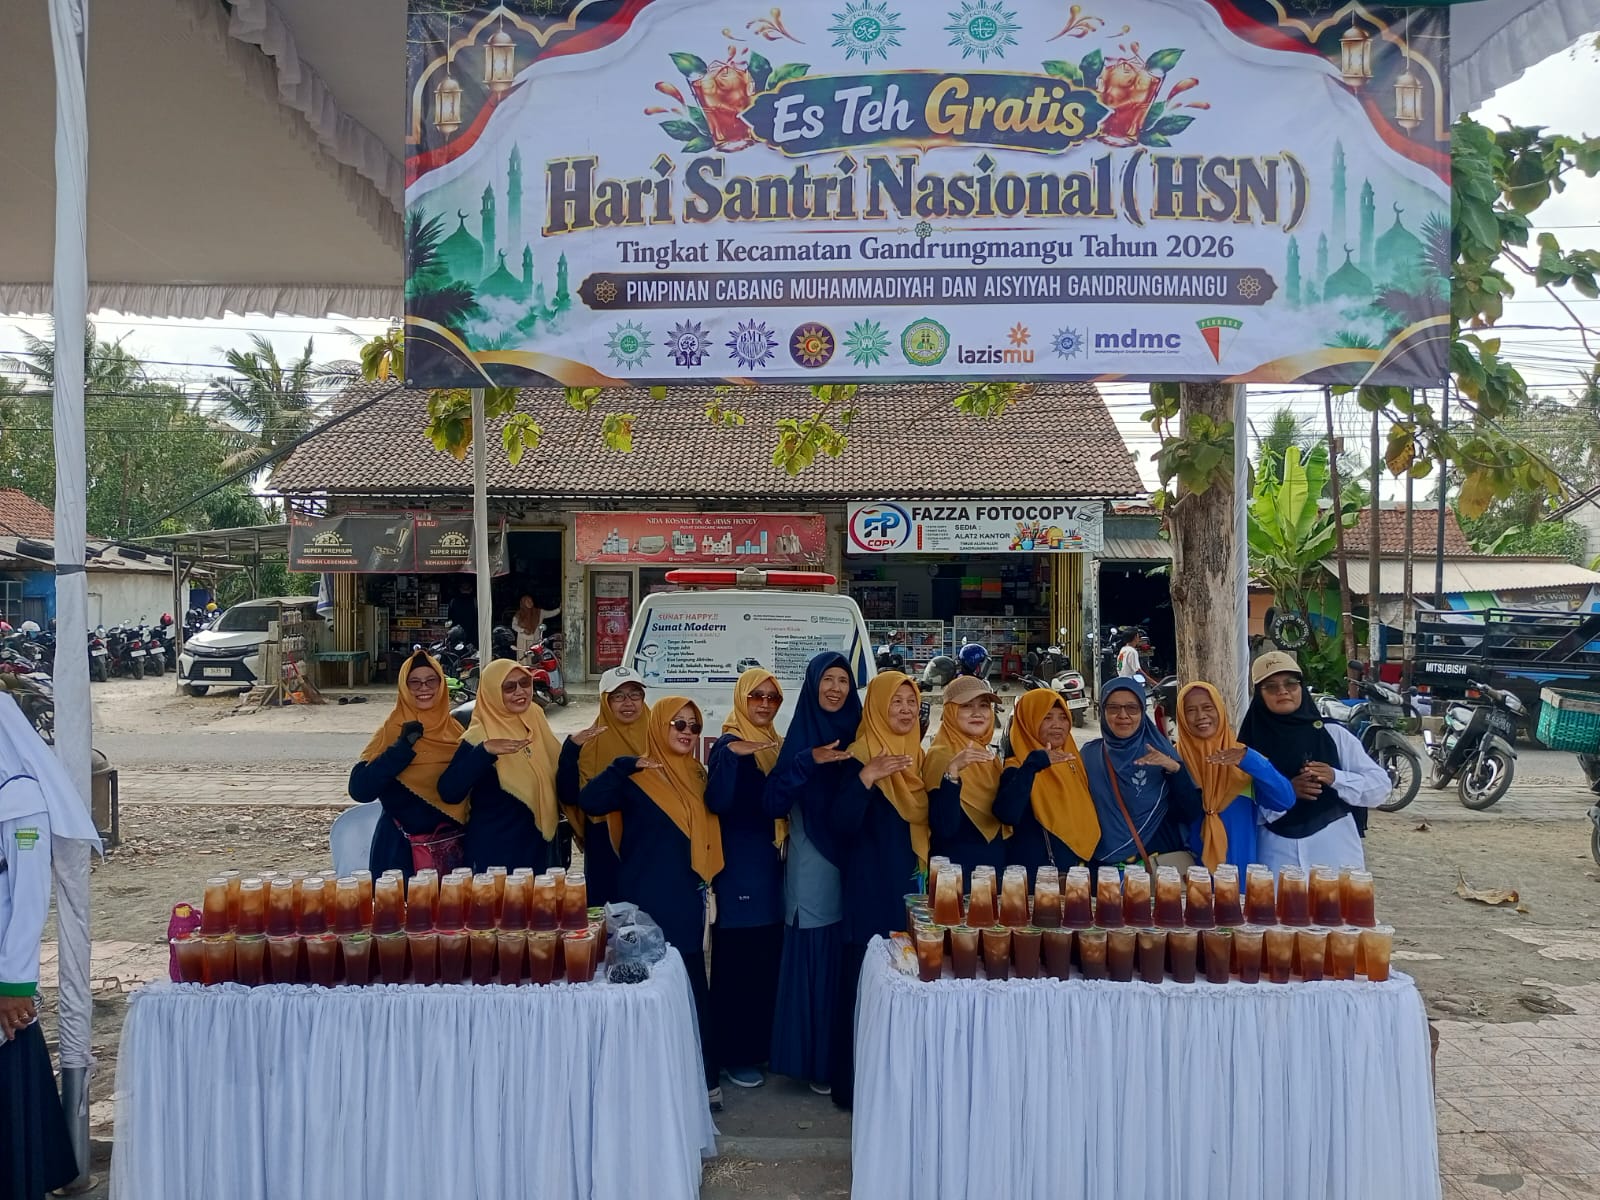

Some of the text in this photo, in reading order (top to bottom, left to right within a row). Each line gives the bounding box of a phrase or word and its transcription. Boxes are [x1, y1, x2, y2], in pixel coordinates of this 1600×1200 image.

[773, 77, 1085, 142] Es Teh Gratis
[542, 149, 1309, 237] Hari Santri Nasional (HSN)
[617, 234, 1234, 269] Tingkat Kecamatan Gandrungmangu Tahun 2026
[627, 275, 1228, 302] PIMPINAN CABANG MUHAMMADIYAH DAN AISYIYAH GANDRUNGMANGU
[740, 330, 763, 342] BMT
[1095, 328, 1181, 349] mdmc
[958, 345, 1034, 364] lazismu
[912, 506, 1077, 521] FAZZA FOTOCOPY
[867, 539, 896, 547] COPY
[651, 622, 727, 632] Sunat Modern
[1425, 662, 1467, 675] MITSUBISHI
